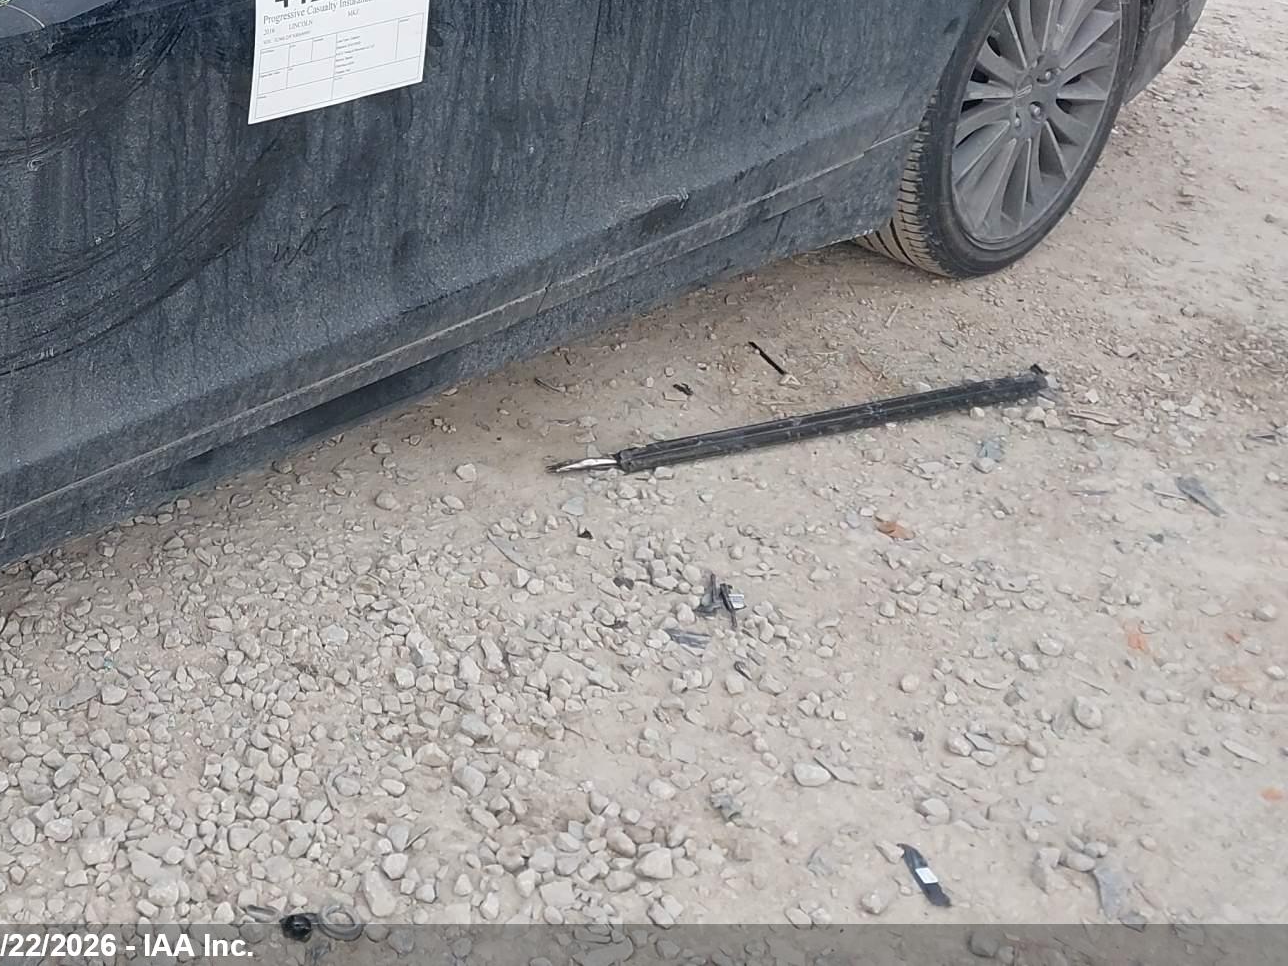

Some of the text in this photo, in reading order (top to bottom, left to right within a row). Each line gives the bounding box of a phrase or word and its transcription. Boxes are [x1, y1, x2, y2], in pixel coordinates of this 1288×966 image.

[263, 7, 306, 25] Progressive
[307, 0, 337, 16] Casualty
[288, 19, 313, 30] LINCOLN
